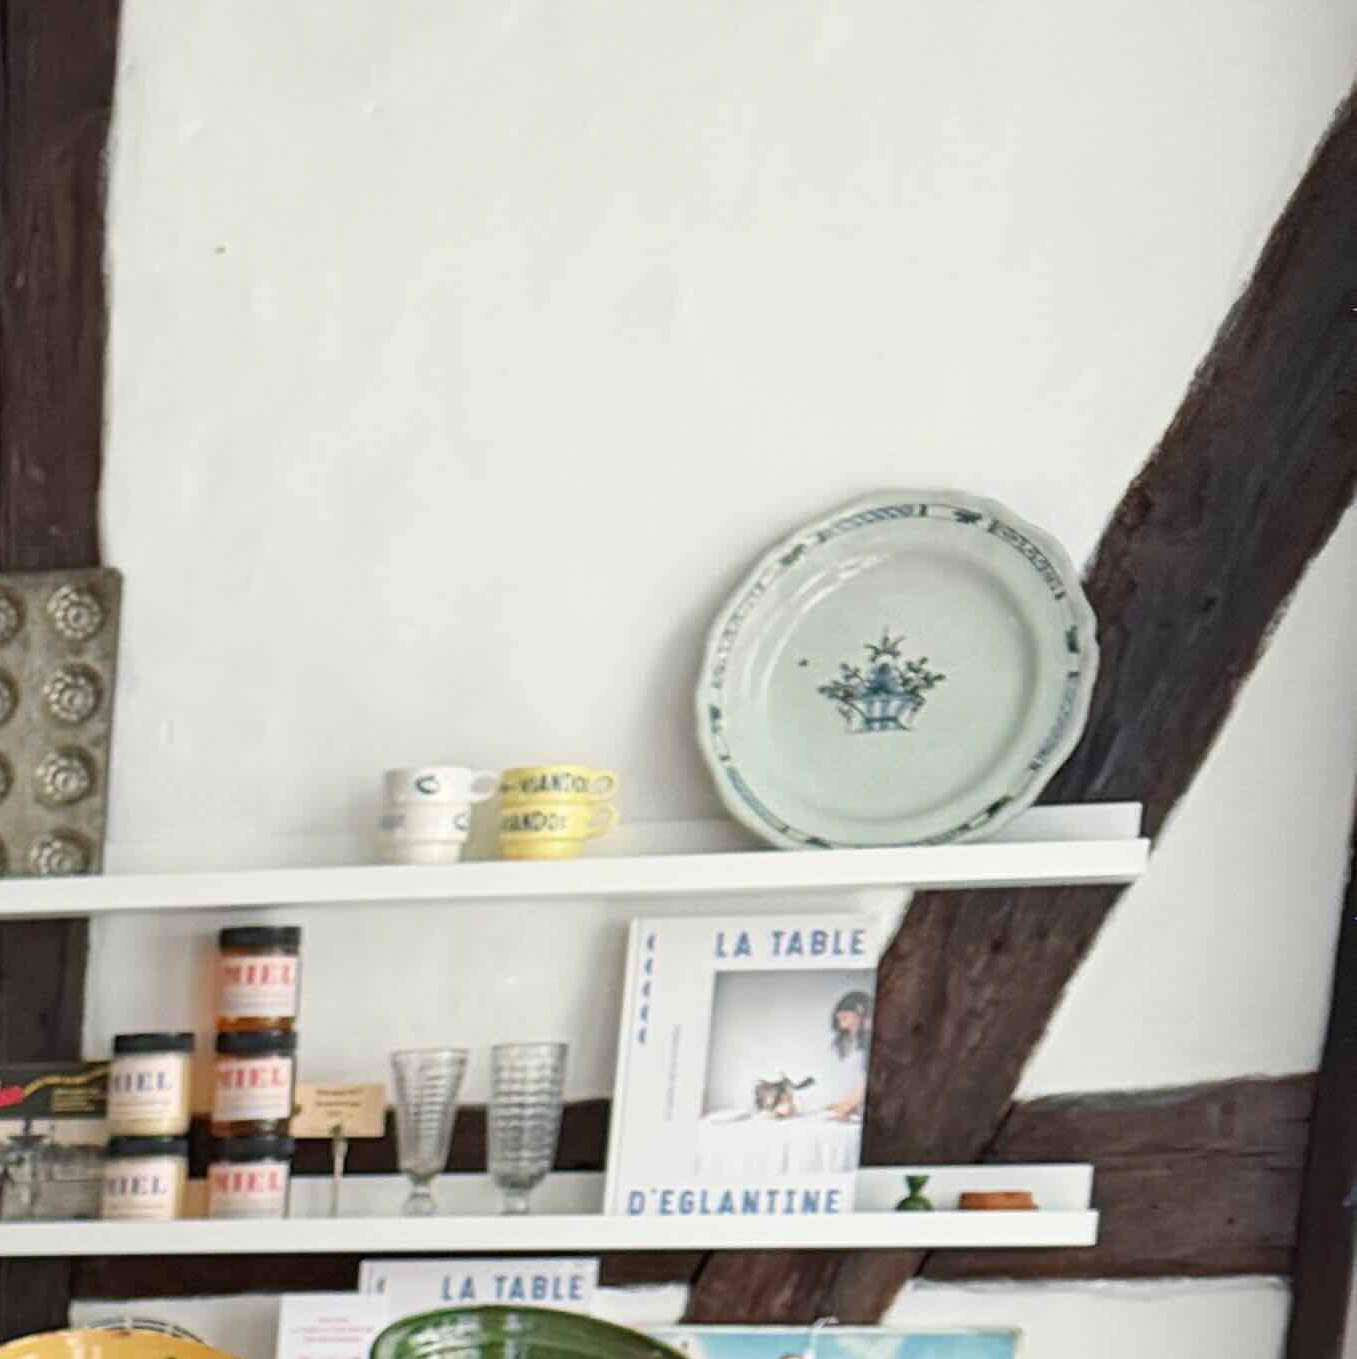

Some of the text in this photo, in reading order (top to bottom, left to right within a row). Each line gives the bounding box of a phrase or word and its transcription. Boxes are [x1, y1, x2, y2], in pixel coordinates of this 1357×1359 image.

[714, 929, 867, 958] LA TABLE
[628, 1188, 842, 1216] D'EGLANTINE
[442, 1275, 585, 1300] LA TABLE
